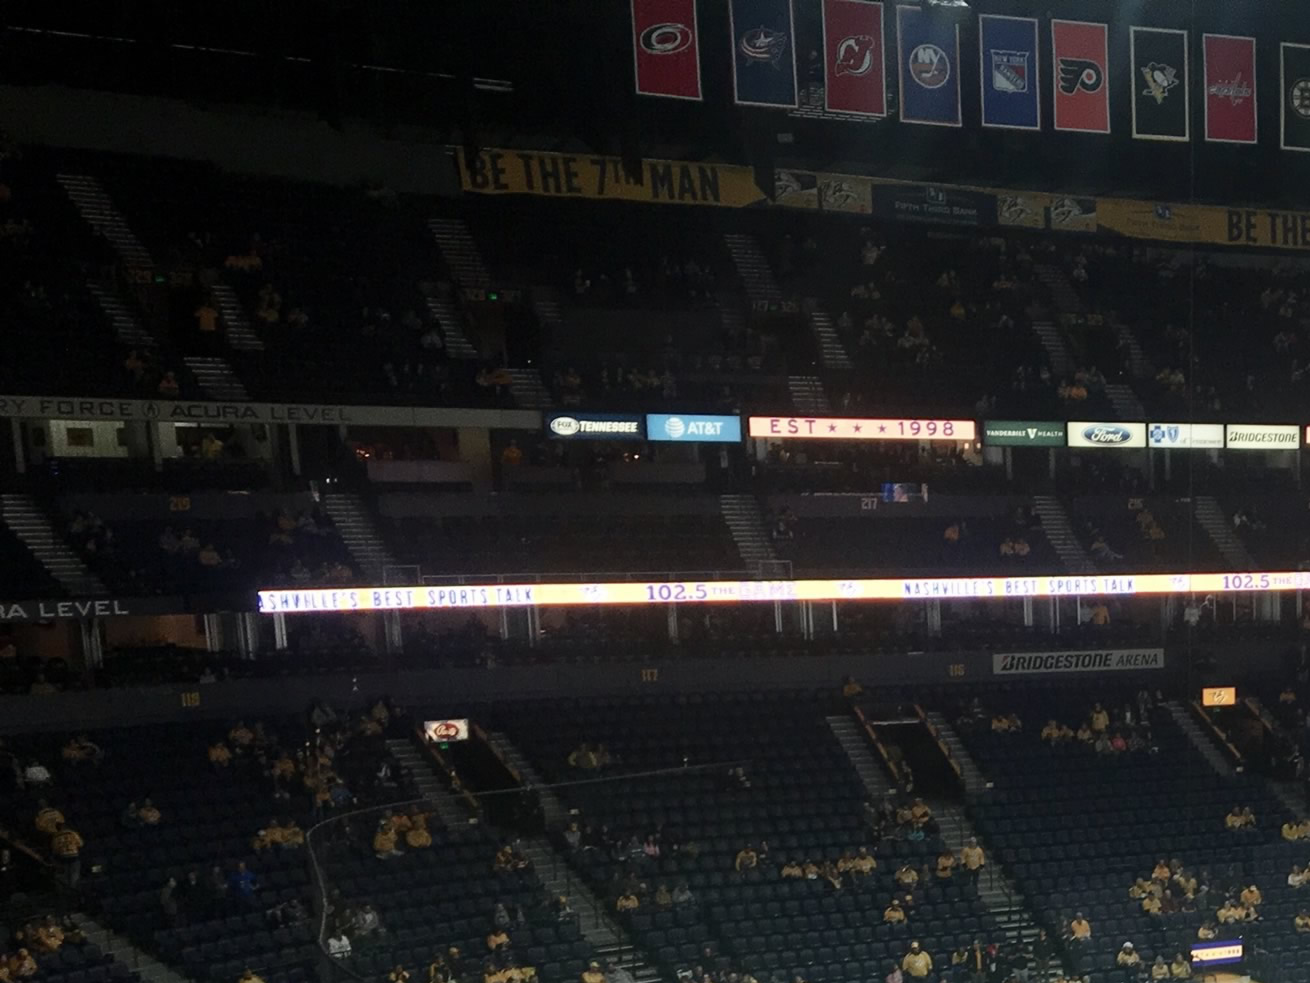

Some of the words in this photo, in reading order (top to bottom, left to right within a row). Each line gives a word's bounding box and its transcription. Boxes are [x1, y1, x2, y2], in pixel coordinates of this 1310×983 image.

[468, 151, 509, 190] BE
[516, 153, 581, 194] THE
[650, 162, 721, 203] MAN
[1227, 210, 1258, 243] BE
[40, 402, 133, 416] FORCE
[170, 403, 259, 419] ACURA
[271, 406, 353, 422] LEVEL
[579, 420, 638, 433] TENNESSEE
[687, 421, 723, 435] AT&T
[770, 419, 816, 434] EST
[898, 421, 955, 436] 1998
[986, 429, 1026, 437] VANDERBILT
[1091, 427, 1123, 443] Ford
[1228, 431, 1298, 443] BRIDGESTONE
[1005, 578, 1037, 594] BEST
[1049, 577, 1097, 593] SPORTS
[1103, 577, 1135, 591] TALK
[1222, 574, 1269, 589] 102.5
[373, 590, 413, 607] BEST
[428, 588, 488, 605] SPORTS
[497, 588, 533, 603] TALK
[647, 584, 708, 601] 102.5
[39, 600, 129, 617] LEVEL
[1001, 652, 1112, 671] BRIDGESTONE
[1116, 653, 1159, 668] ARENA
